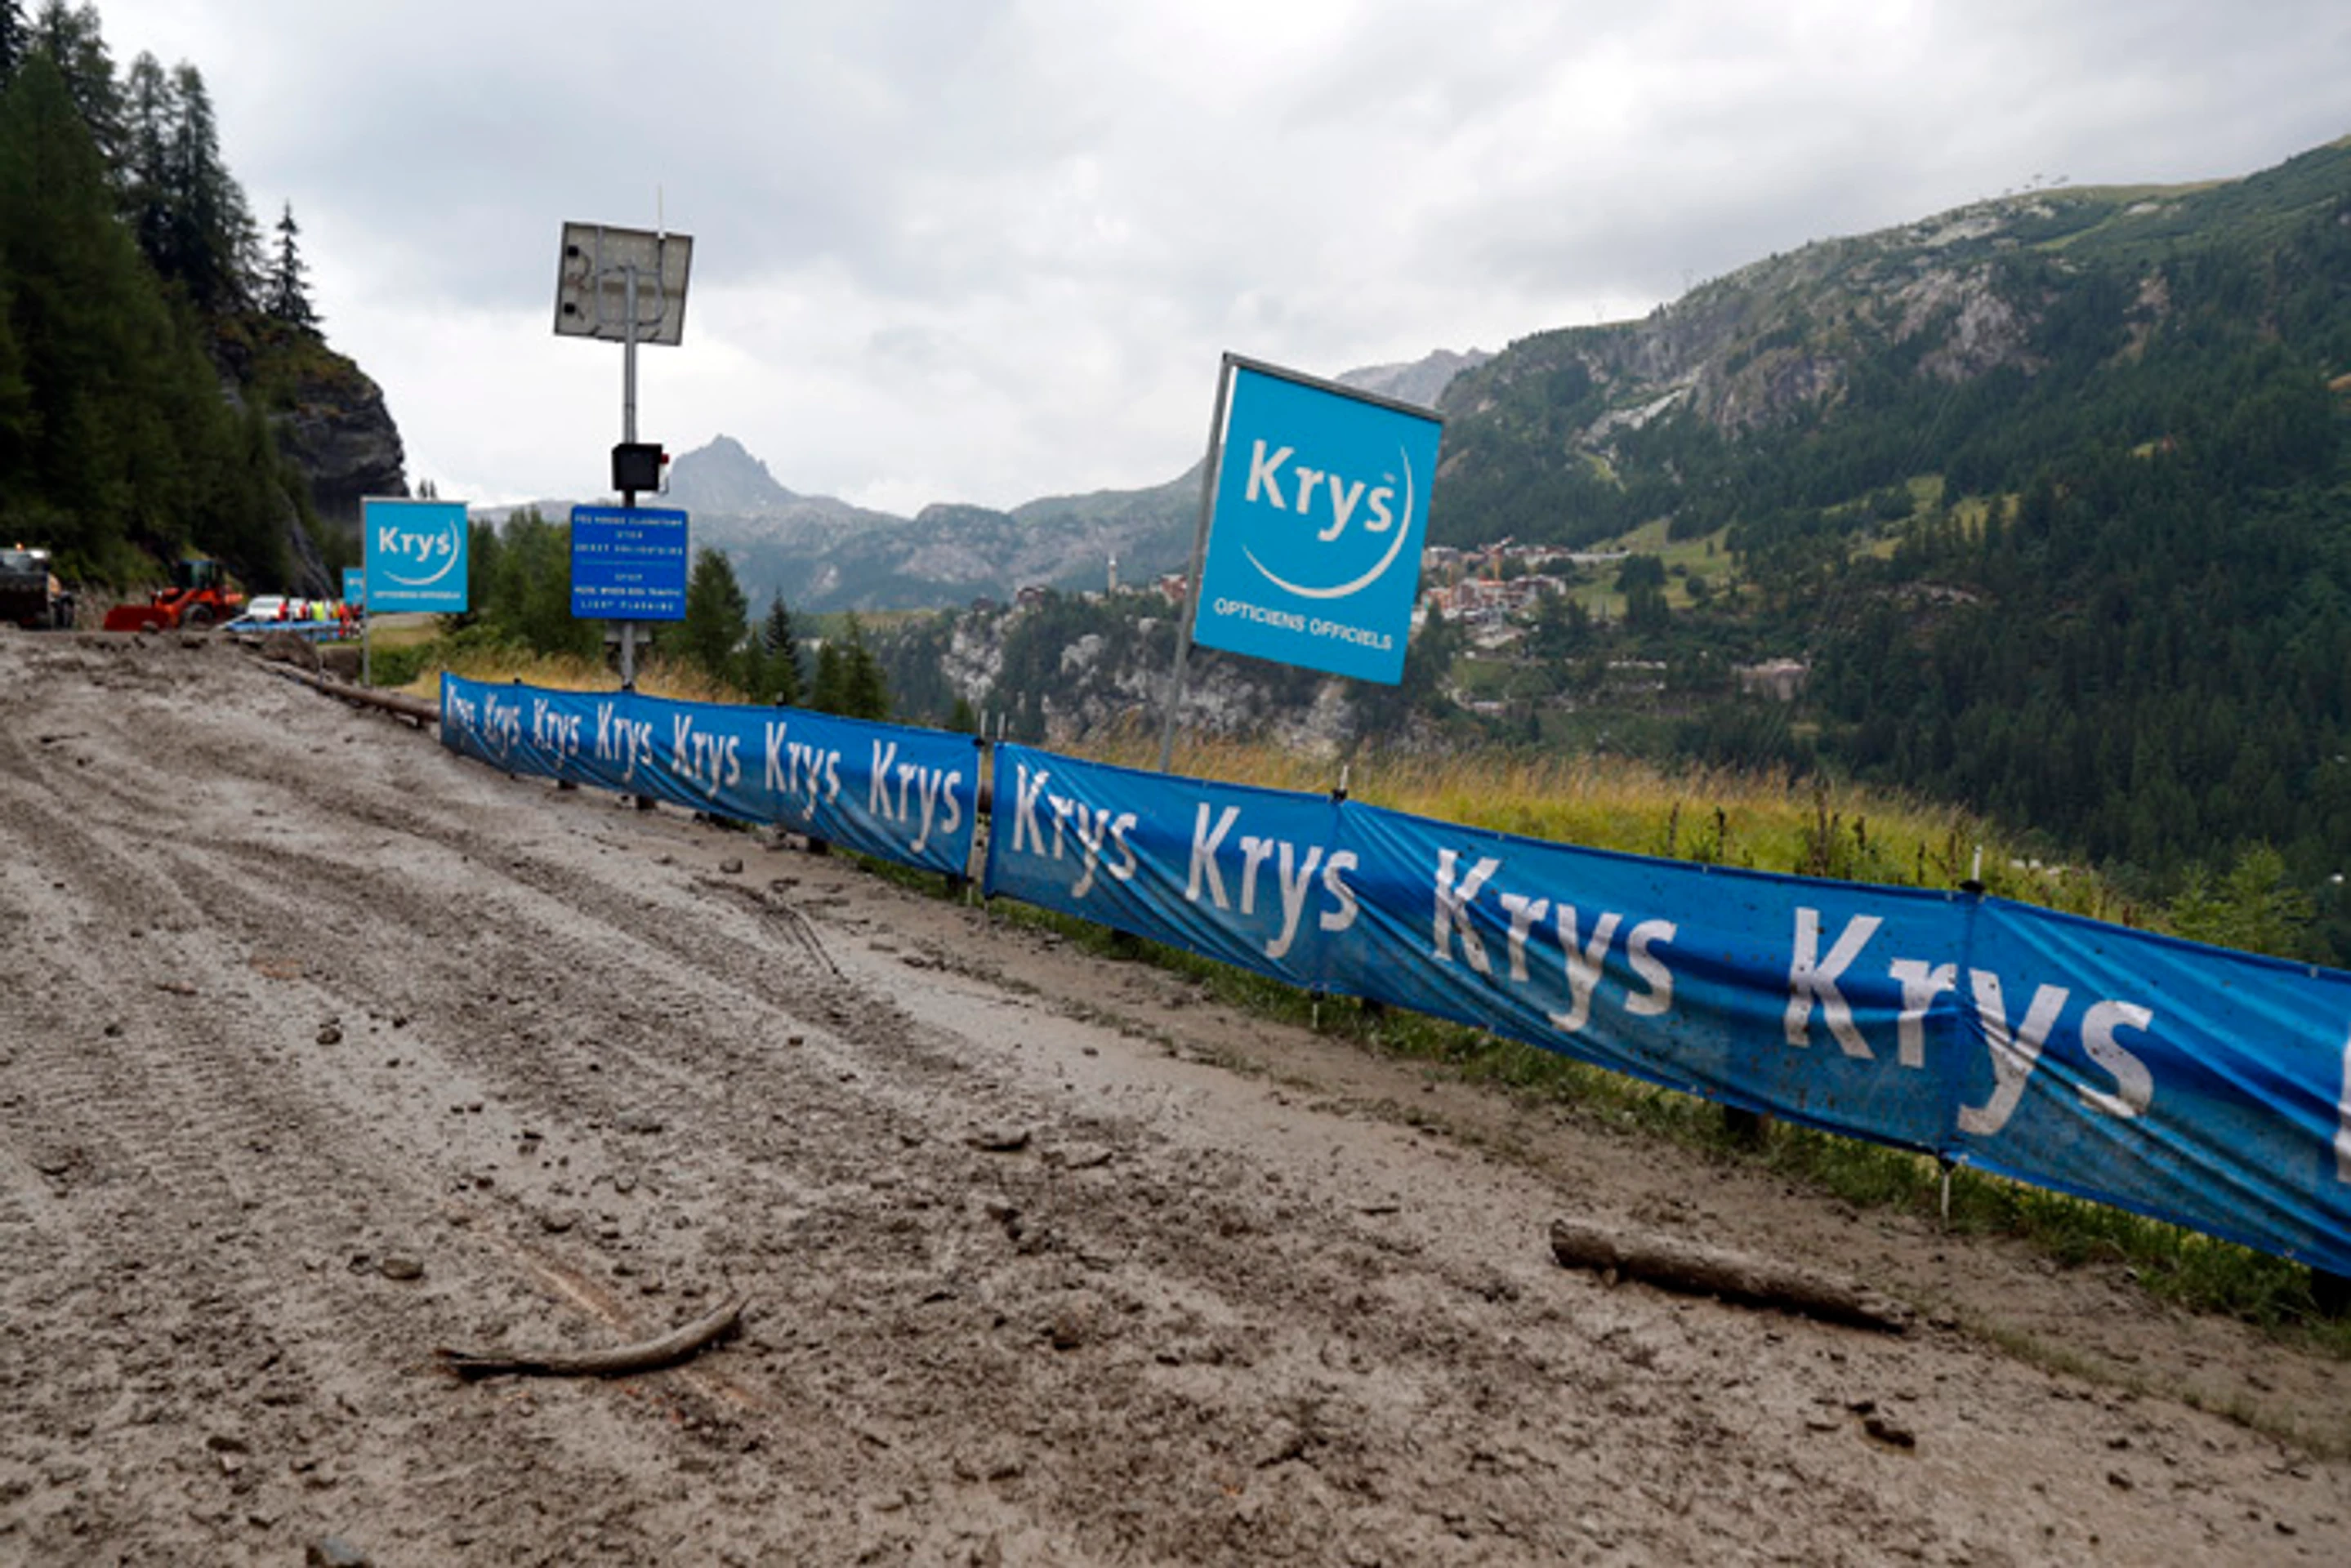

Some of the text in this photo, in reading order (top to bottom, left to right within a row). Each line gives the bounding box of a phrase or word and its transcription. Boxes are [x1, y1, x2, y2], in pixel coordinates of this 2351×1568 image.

[1244, 439, 1395, 542] Krys
[378, 525, 451, 563] Krys
[1212, 598, 1394, 651] OPTICIENS OFFICIELS
[533, 697, 582, 770] Krys
[595, 701, 653, 782] Krys
[671, 713, 740, 800] Krys
[765, 721, 841, 822] Krys
[869, 738, 962, 853] Krys
[1011, 763, 1138, 898] Krys
[1184, 801, 1359, 959] Krys
[1433, 847, 1679, 1032] Krys
[1782, 906, 2154, 1137] Krys
